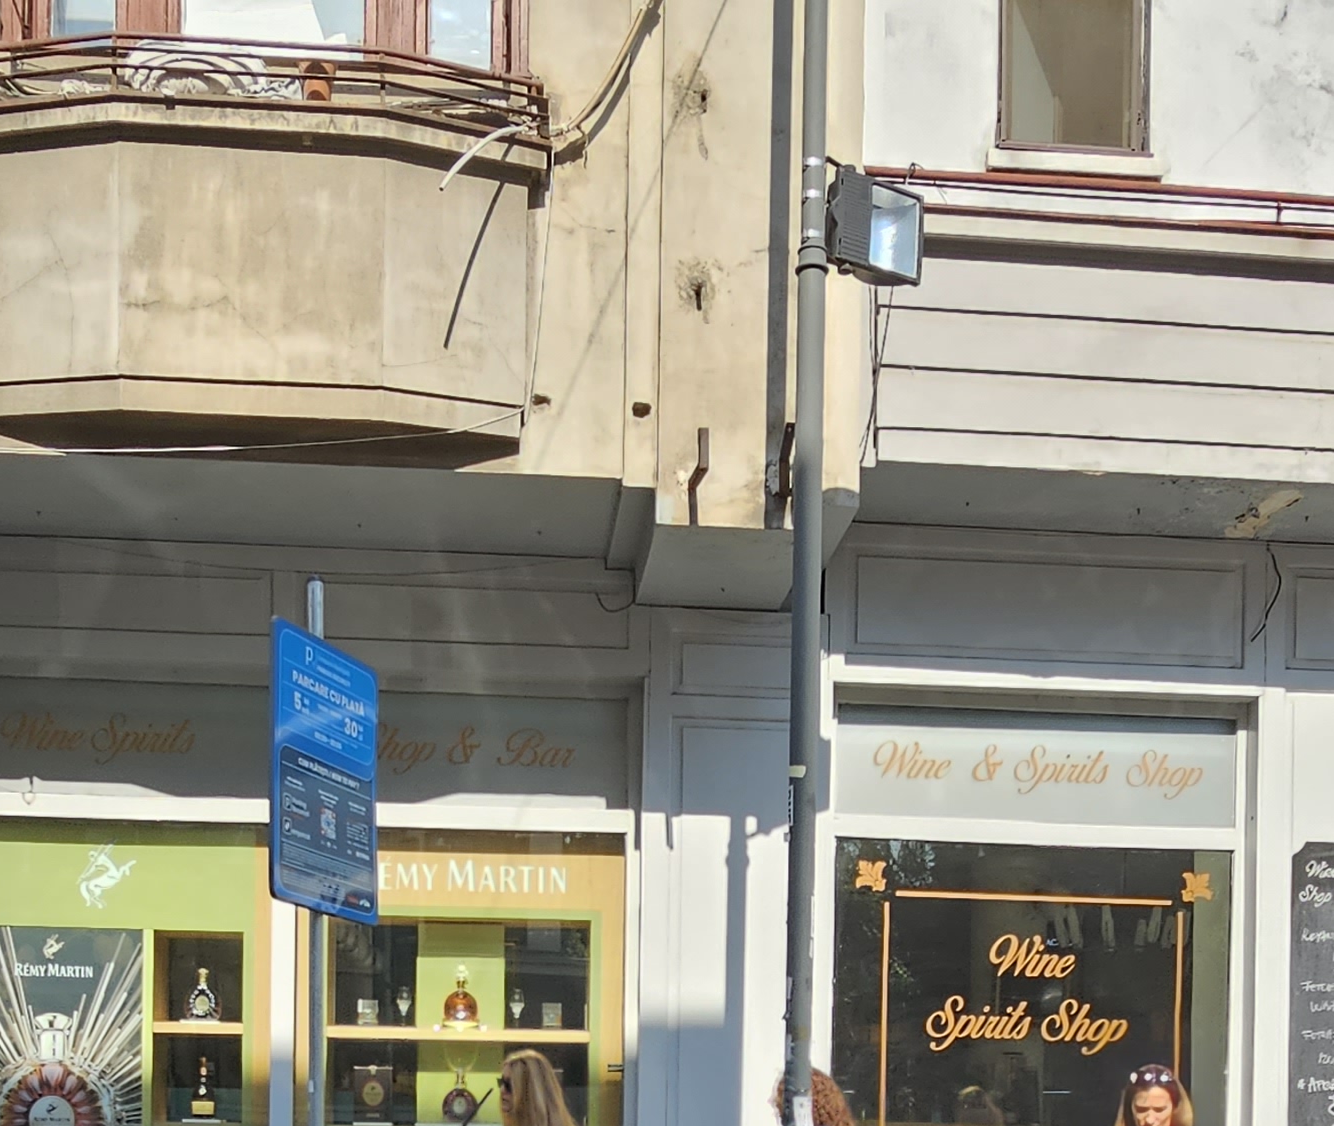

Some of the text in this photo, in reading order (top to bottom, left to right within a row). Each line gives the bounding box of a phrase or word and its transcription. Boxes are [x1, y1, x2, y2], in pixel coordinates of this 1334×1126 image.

[292, 669, 329, 699] PARCARE
[329, 689, 341, 705] CU
[293, 691, 302, 711] 5
[0, 711, 197, 765] Wine Spirits
[344, 717, 358, 738] 30
[378, 722, 437, 776] hop
[446, 725, 481, 765] &
[497, 727, 576, 768] Bar
[873, 740, 1203, 800] Wine & Spirits Shop
[378, 857, 438, 891] ÉMY
[448, 859, 567, 894] MARTIN
[1299, 884, 1332, 908] Shop
[14, 963, 93, 978] RÉMY MARTIN
[989, 934, 1075, 978] Wine
[926, 995, 1128, 1056] Spirits Shop
